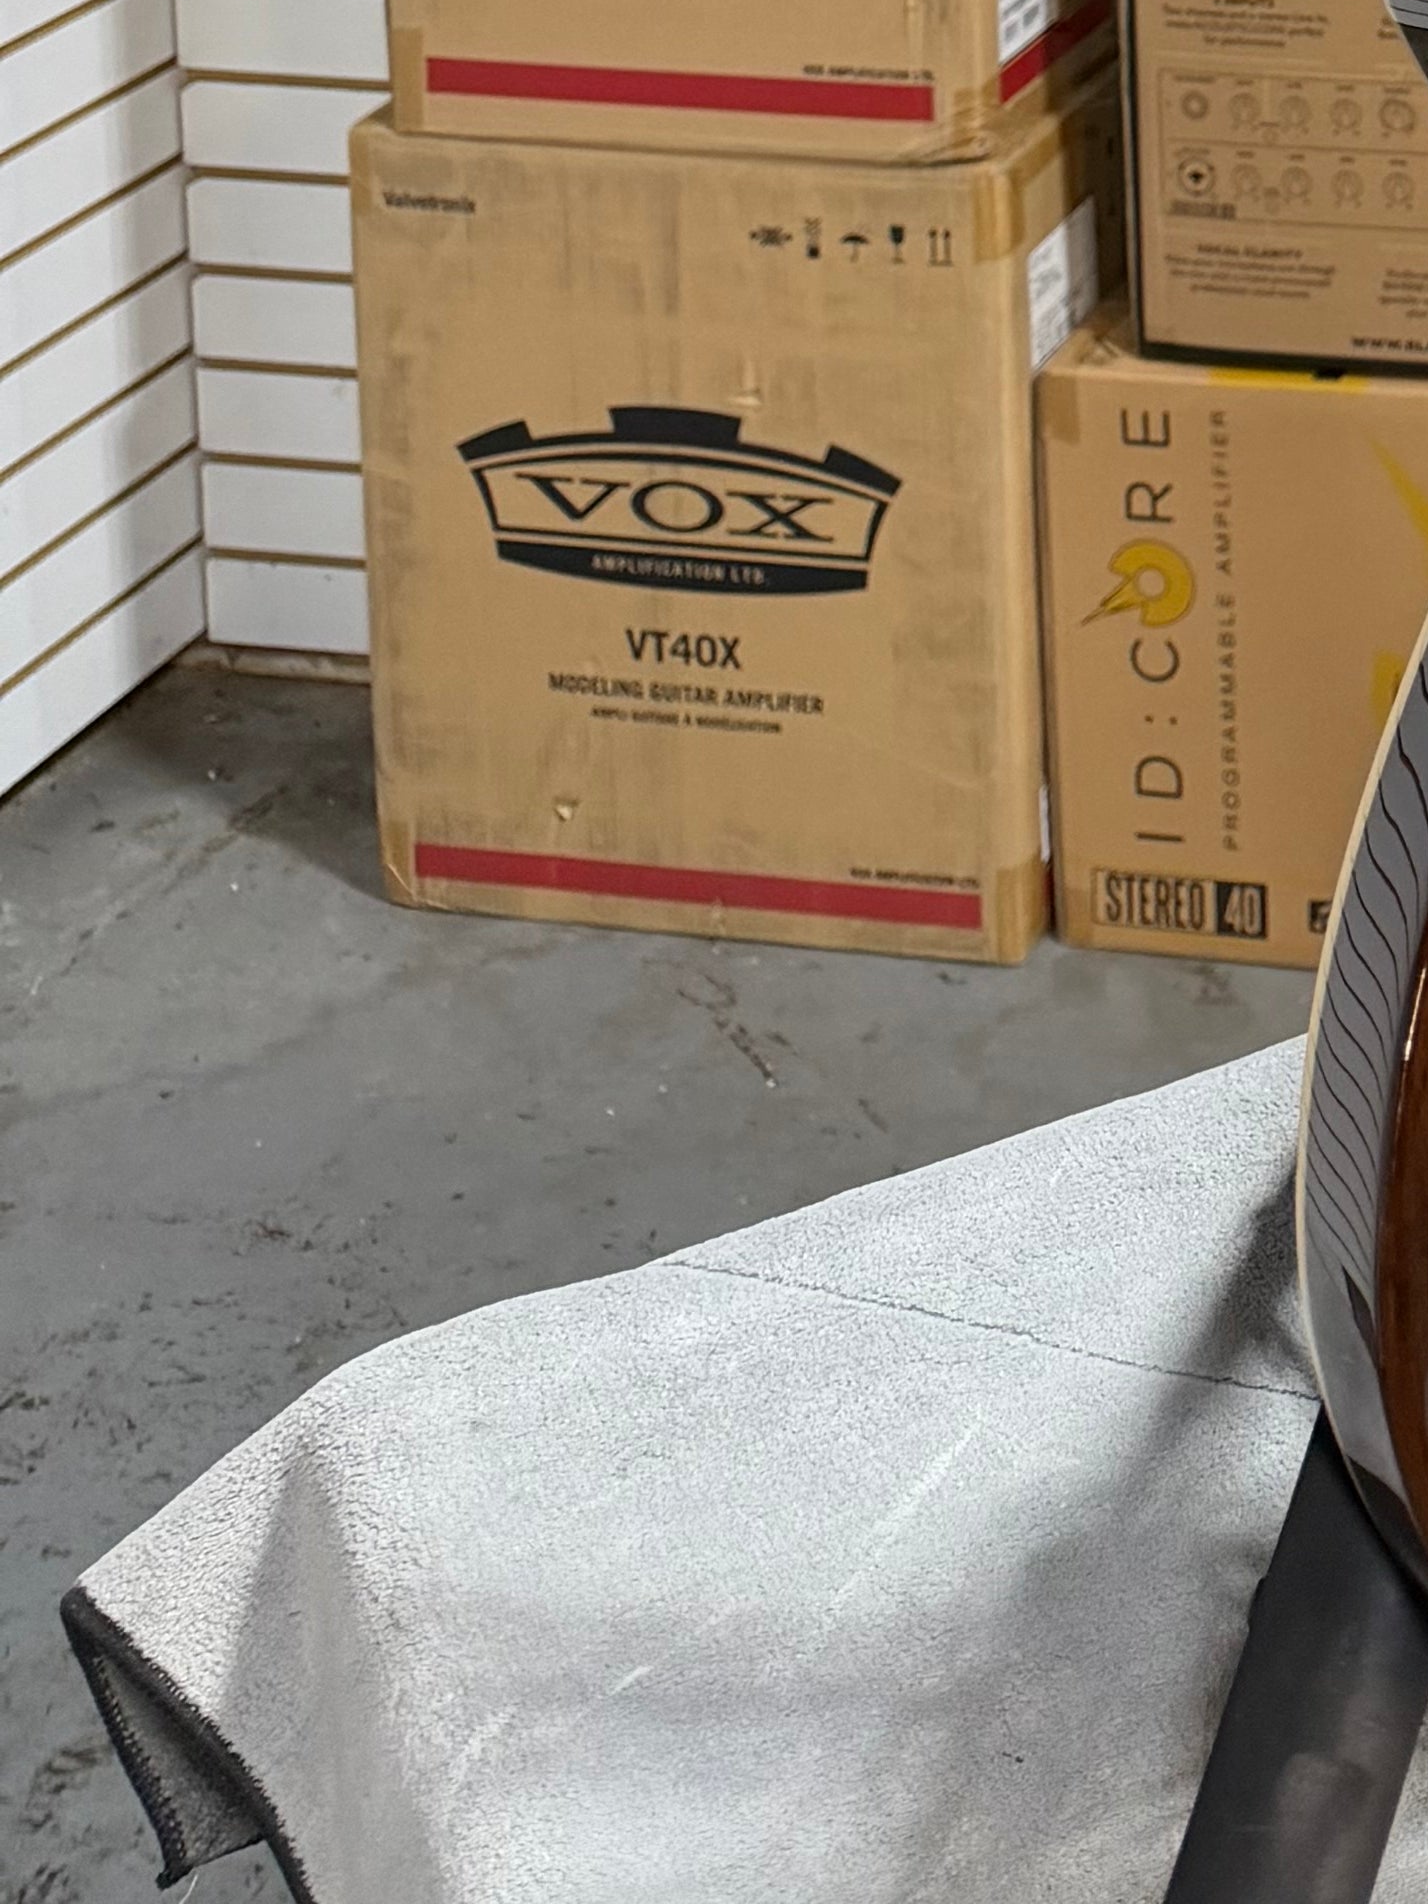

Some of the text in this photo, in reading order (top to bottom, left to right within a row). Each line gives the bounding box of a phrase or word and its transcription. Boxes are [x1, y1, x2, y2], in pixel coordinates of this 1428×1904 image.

[513, 471, 836, 544] VOX
[591, 554, 725, 581] AMPLIFICATION
[625, 628, 743, 670] VT40X
[1209, 409, 1239, 852] PROGRAMMABLE AMPLIFIER
[548, 671, 825, 717] MODELING GUITAR AMPLIFIER
[1103, 871, 1261, 938] STEREO 40
